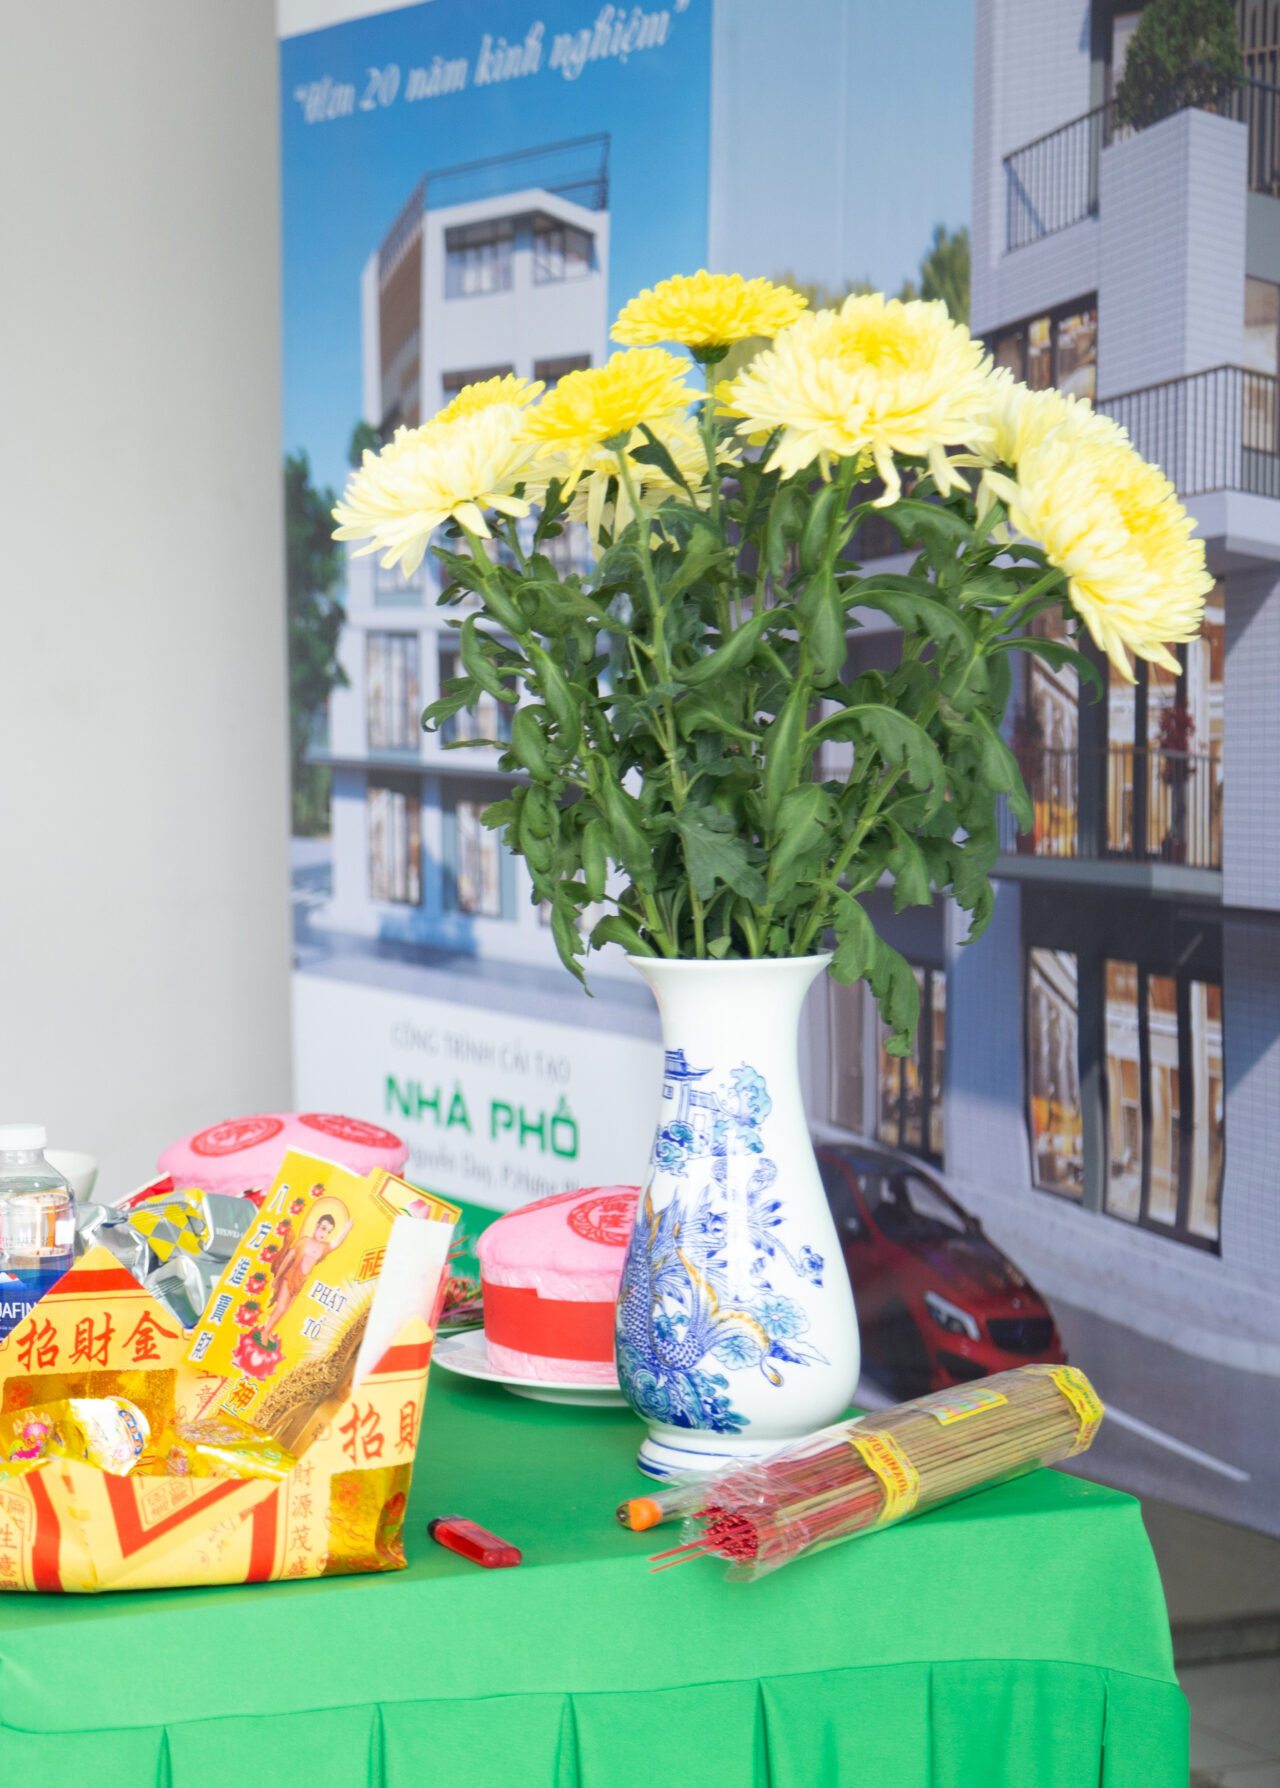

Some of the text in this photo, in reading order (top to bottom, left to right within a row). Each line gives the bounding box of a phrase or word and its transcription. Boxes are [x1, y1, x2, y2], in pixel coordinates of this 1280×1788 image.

[360, 64, 400, 111] 20
[404, 56, 469, 102] năm
[474, 21, 545, 86] kinh
[386, 1074, 471, 1133] NHÀ
[491, 1095, 579, 1160] PHỐ
[17, 1310, 179, 1372] 招財金
